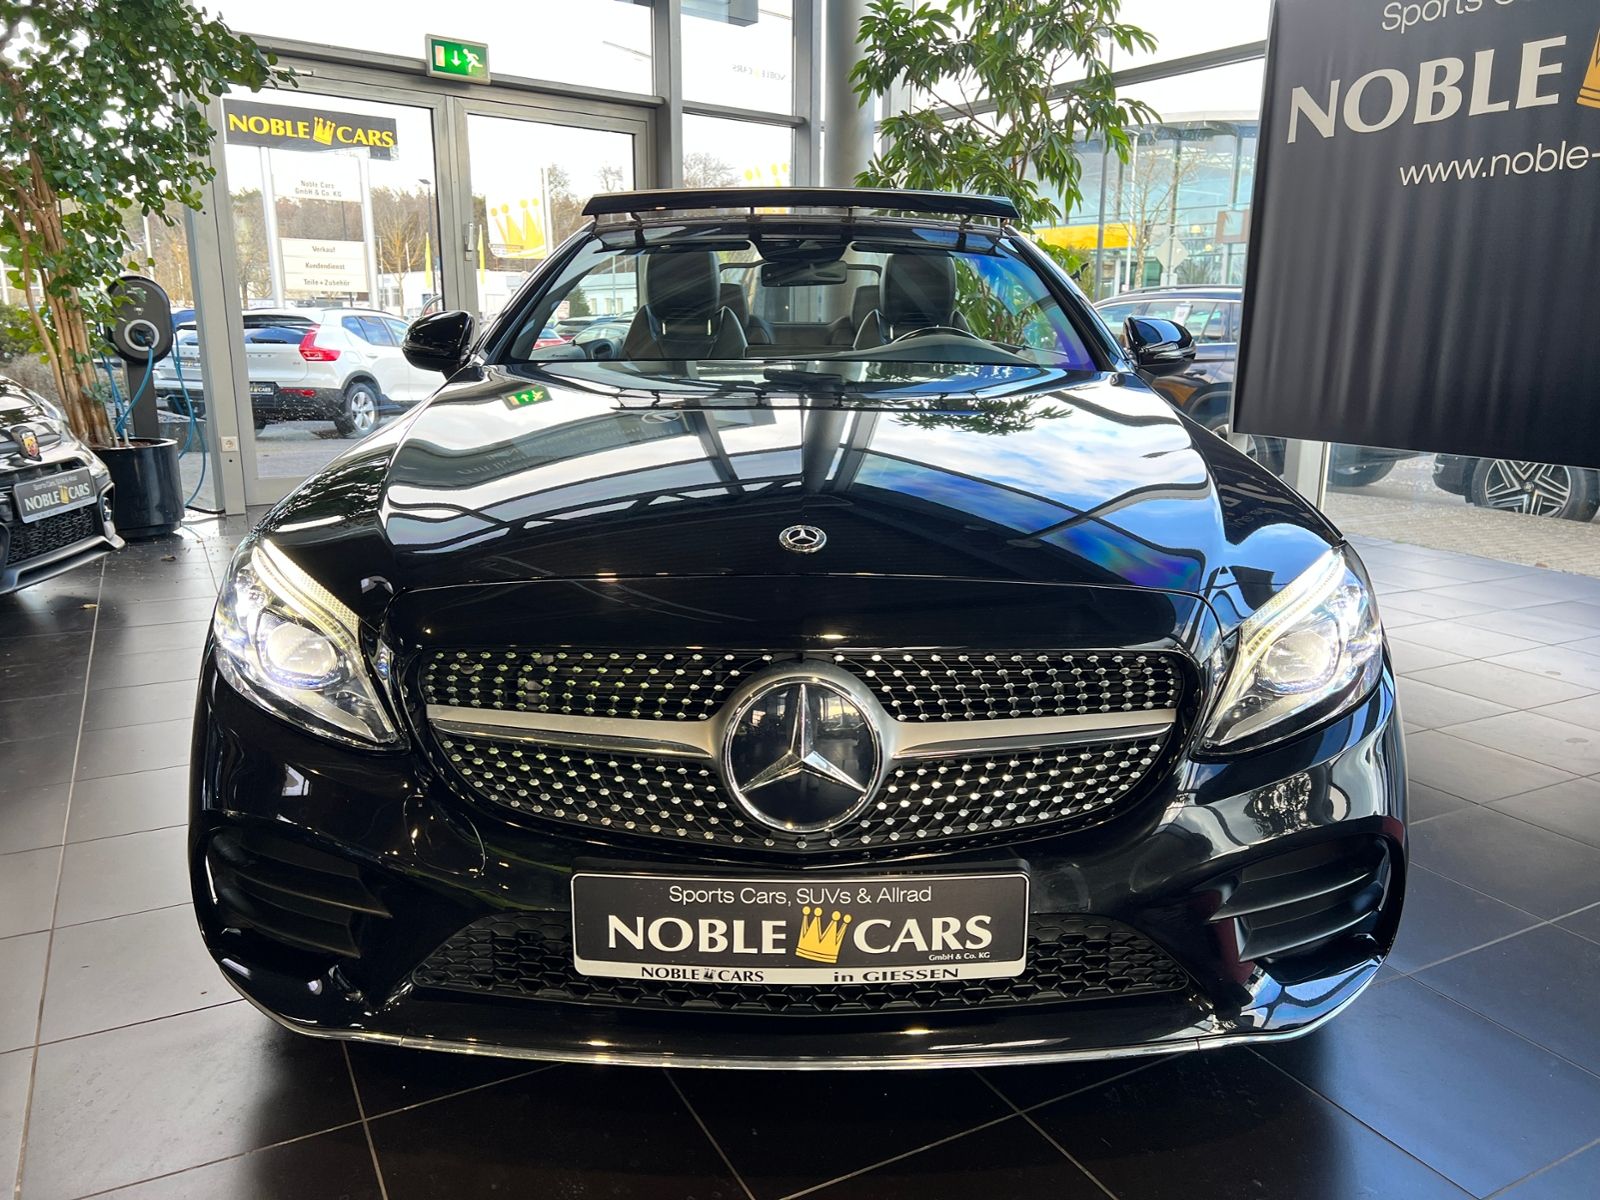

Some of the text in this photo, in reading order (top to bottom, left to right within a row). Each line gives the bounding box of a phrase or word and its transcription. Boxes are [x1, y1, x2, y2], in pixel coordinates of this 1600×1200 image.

[1287, 35, 1567, 144] NOBLE
[228, 113, 394, 147] NOBLE CARS
[1399, 140, 1600, 186] www.noble-
[295, 187, 313, 195] GmbH
[305, 262, 345, 270] Kundendienst
[24, 491, 60, 511] NOBLE
[68, 483, 90, 499] CARS
[668, 885, 932, 907] Sports Cars, SUVs & Allrad
[608, 914, 993, 954] NOBLE CARS
[928, 953, 954, 961] GmbH
[963, 952, 977, 960] Co.
[641, 966, 764, 982] NOBLE CARS
[833, 968, 959, 982] in GIESSEN
